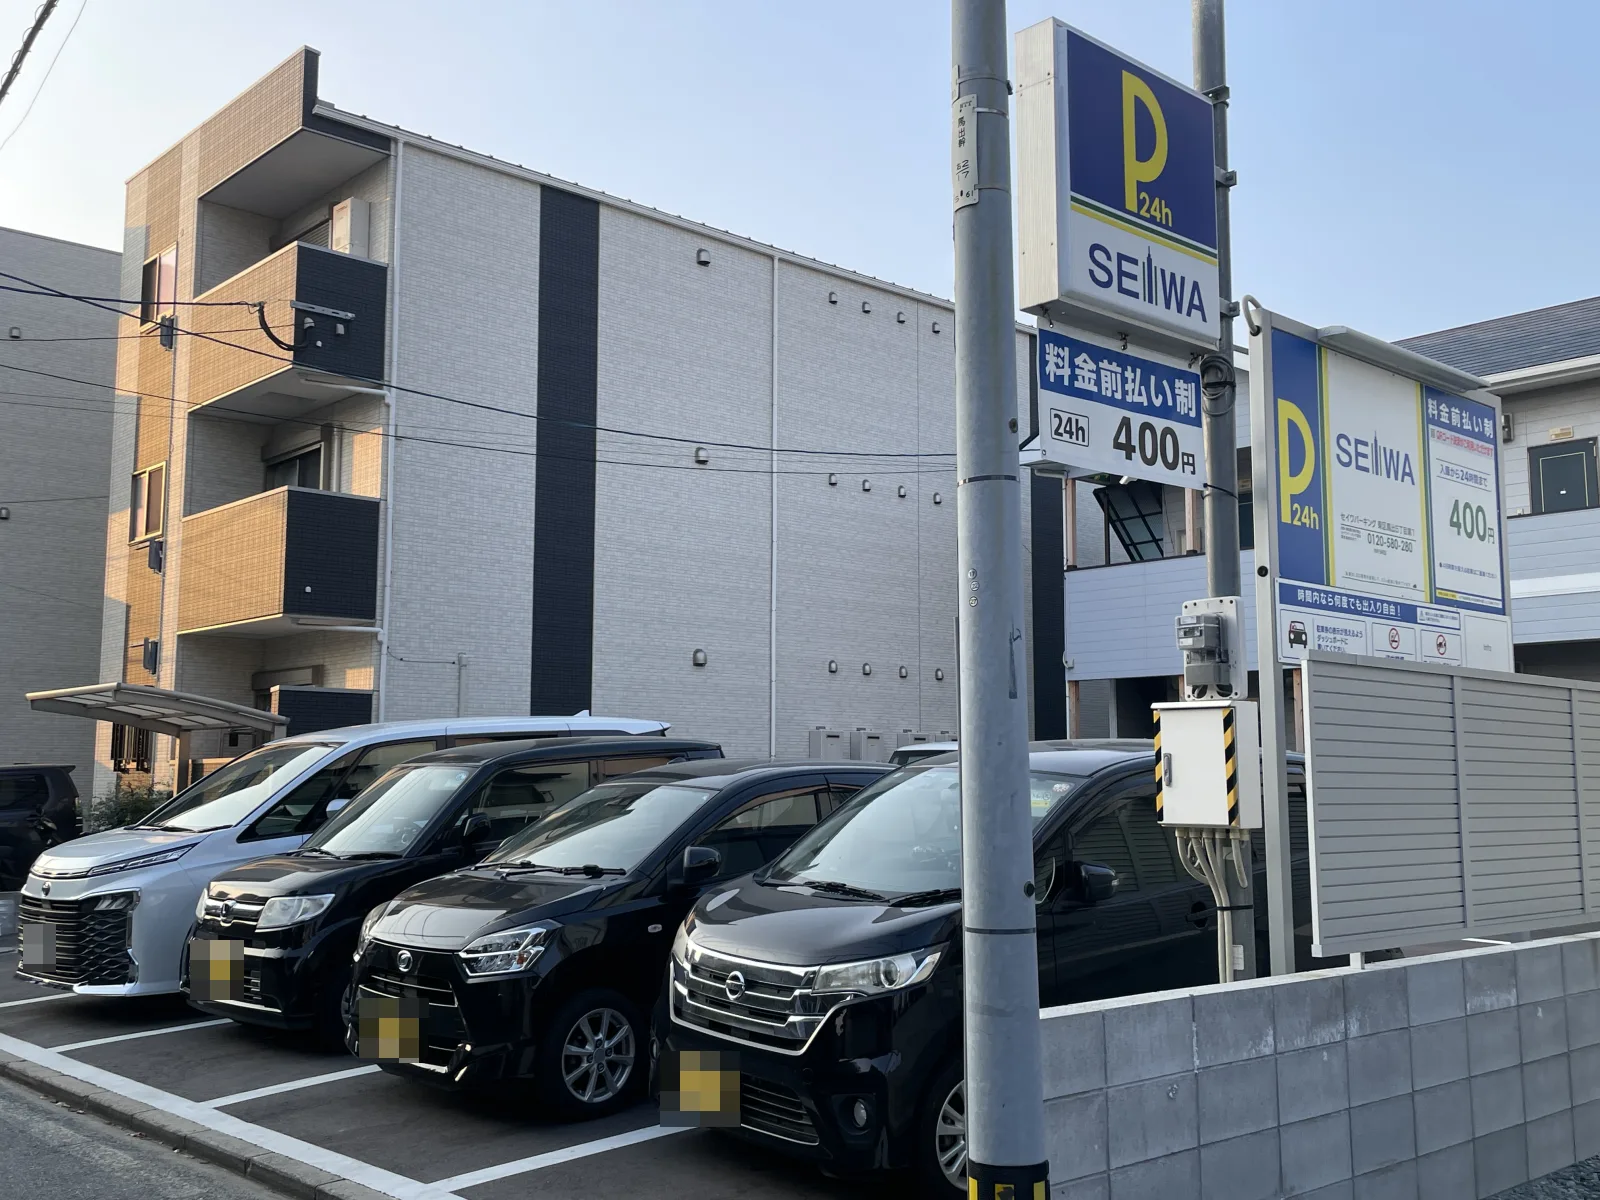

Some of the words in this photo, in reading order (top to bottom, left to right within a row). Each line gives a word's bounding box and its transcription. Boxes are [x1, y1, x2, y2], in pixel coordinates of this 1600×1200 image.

[1122, 70, 1168, 212] P
[1139, 190, 1173, 228] 24h
[1045, 343, 1196, 418] 料金前払い制
[1053, 413, 1086, 443] 24h
[1427, 398, 1494, 439] 料金前払い制
[1112, 415, 1196, 476] 400円
[1277, 398, 1315, 523] P
[1292, 502, 1320, 531] 24h
[1449, 499, 1495, 545] 400円
[1367, 533, 1413, 553] 0120-580-280
